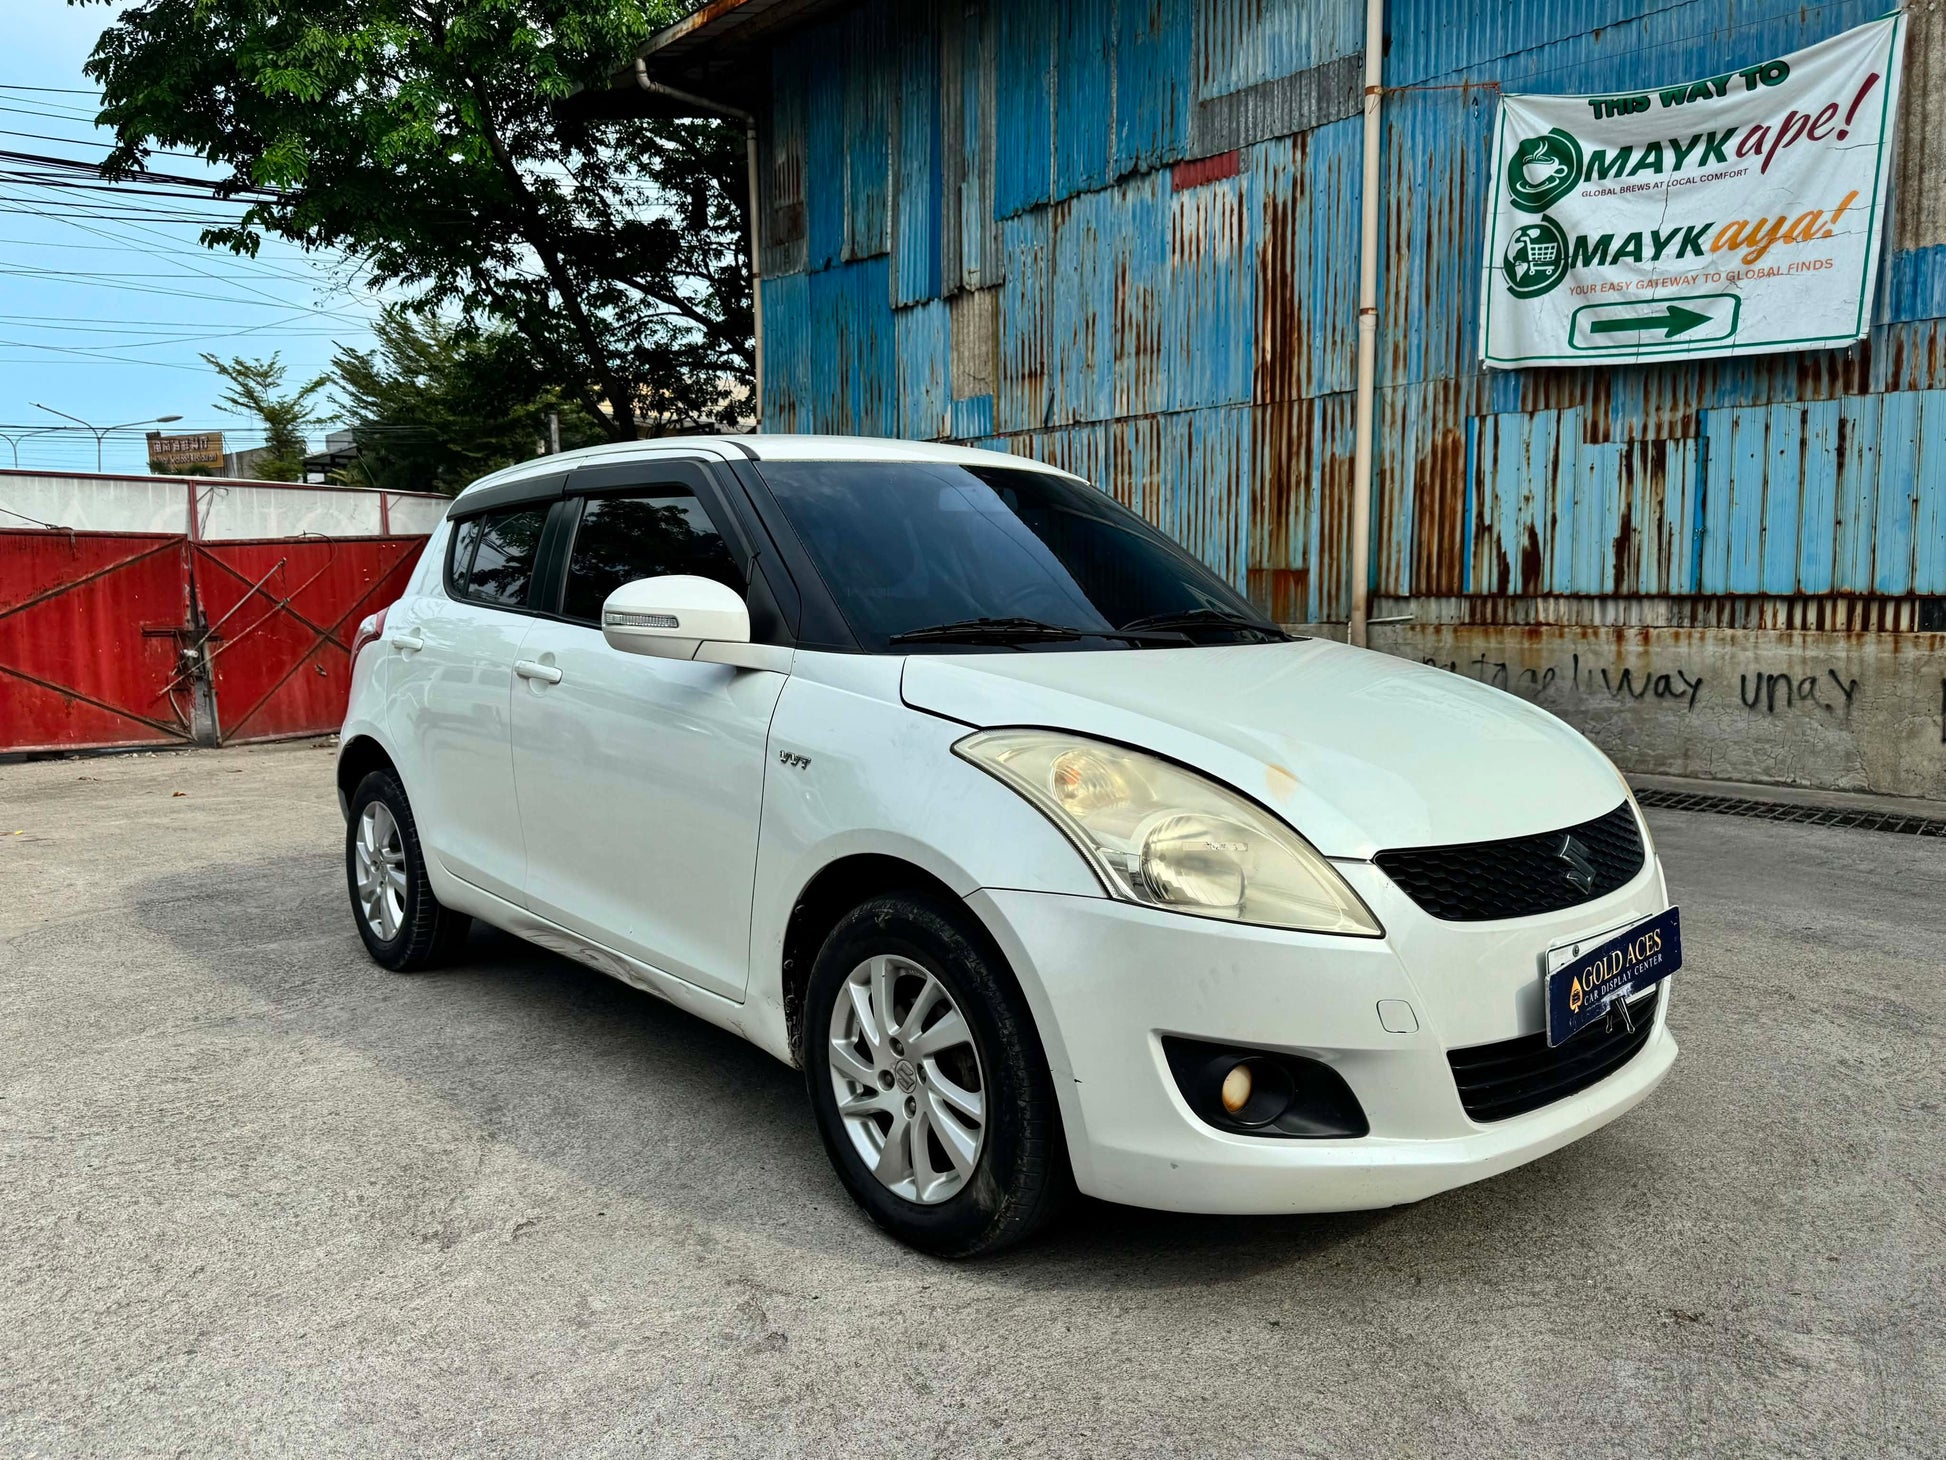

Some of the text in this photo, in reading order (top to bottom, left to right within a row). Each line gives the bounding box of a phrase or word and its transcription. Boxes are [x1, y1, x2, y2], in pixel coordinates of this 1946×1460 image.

[1589, 60, 1790, 120] THIS WAY TO
[1581, 167, 1750, 198] GLOBAL BREWS AT LOCAL COMFORT
[1569, 258, 1834, 296] YOUR EASY GATEWAY TO GLOBAL FINDS
[780, 750, 812, 770] VVT
[1582, 928, 1662, 991] GOLD ACES
[1584, 953, 1663, 1006] CAR DISPLAY CENTER
